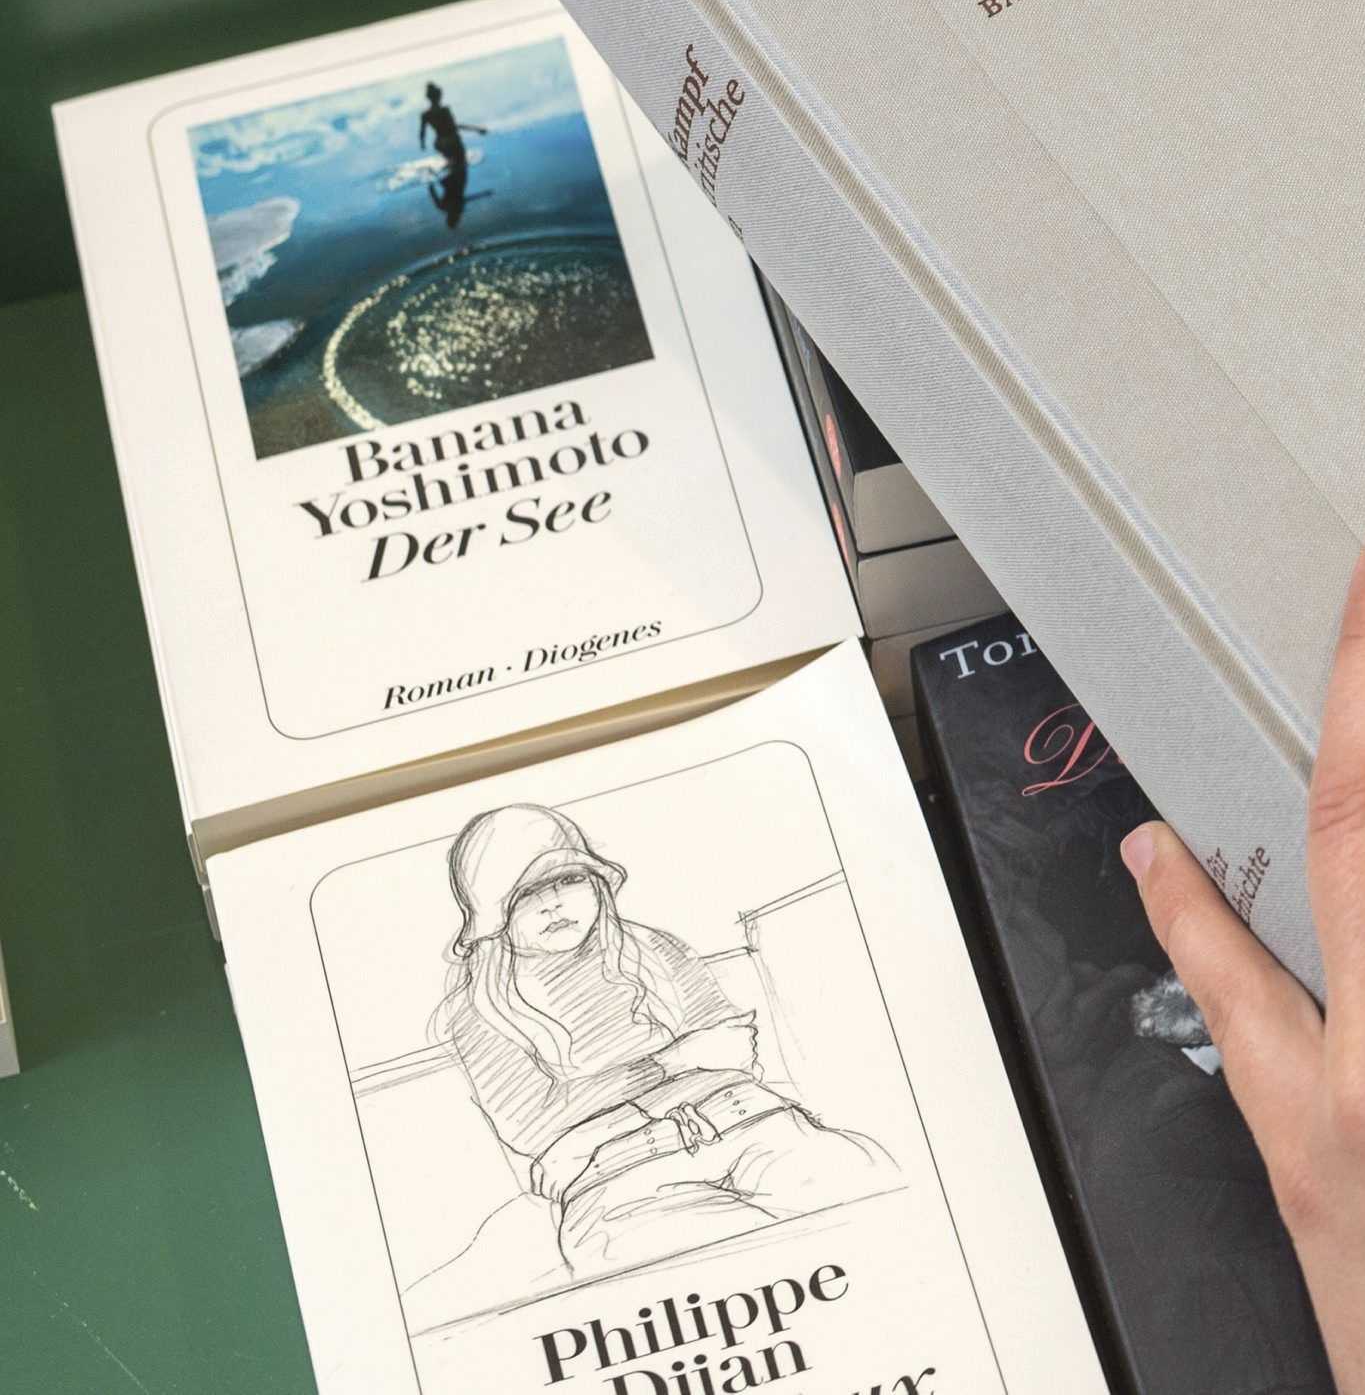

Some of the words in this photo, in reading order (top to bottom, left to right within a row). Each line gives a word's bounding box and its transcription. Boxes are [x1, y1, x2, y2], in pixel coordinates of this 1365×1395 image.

[295, 429, 651, 540] Yoshimoto
[339, 399, 591, 487] Banana
[361, 522, 488, 584] Der
[500, 490, 614, 548] See
[383, 666, 496, 710] Roman
[523, 619, 663, 674] Diogenes
[532, 1264, 850, 1387] Philippe
